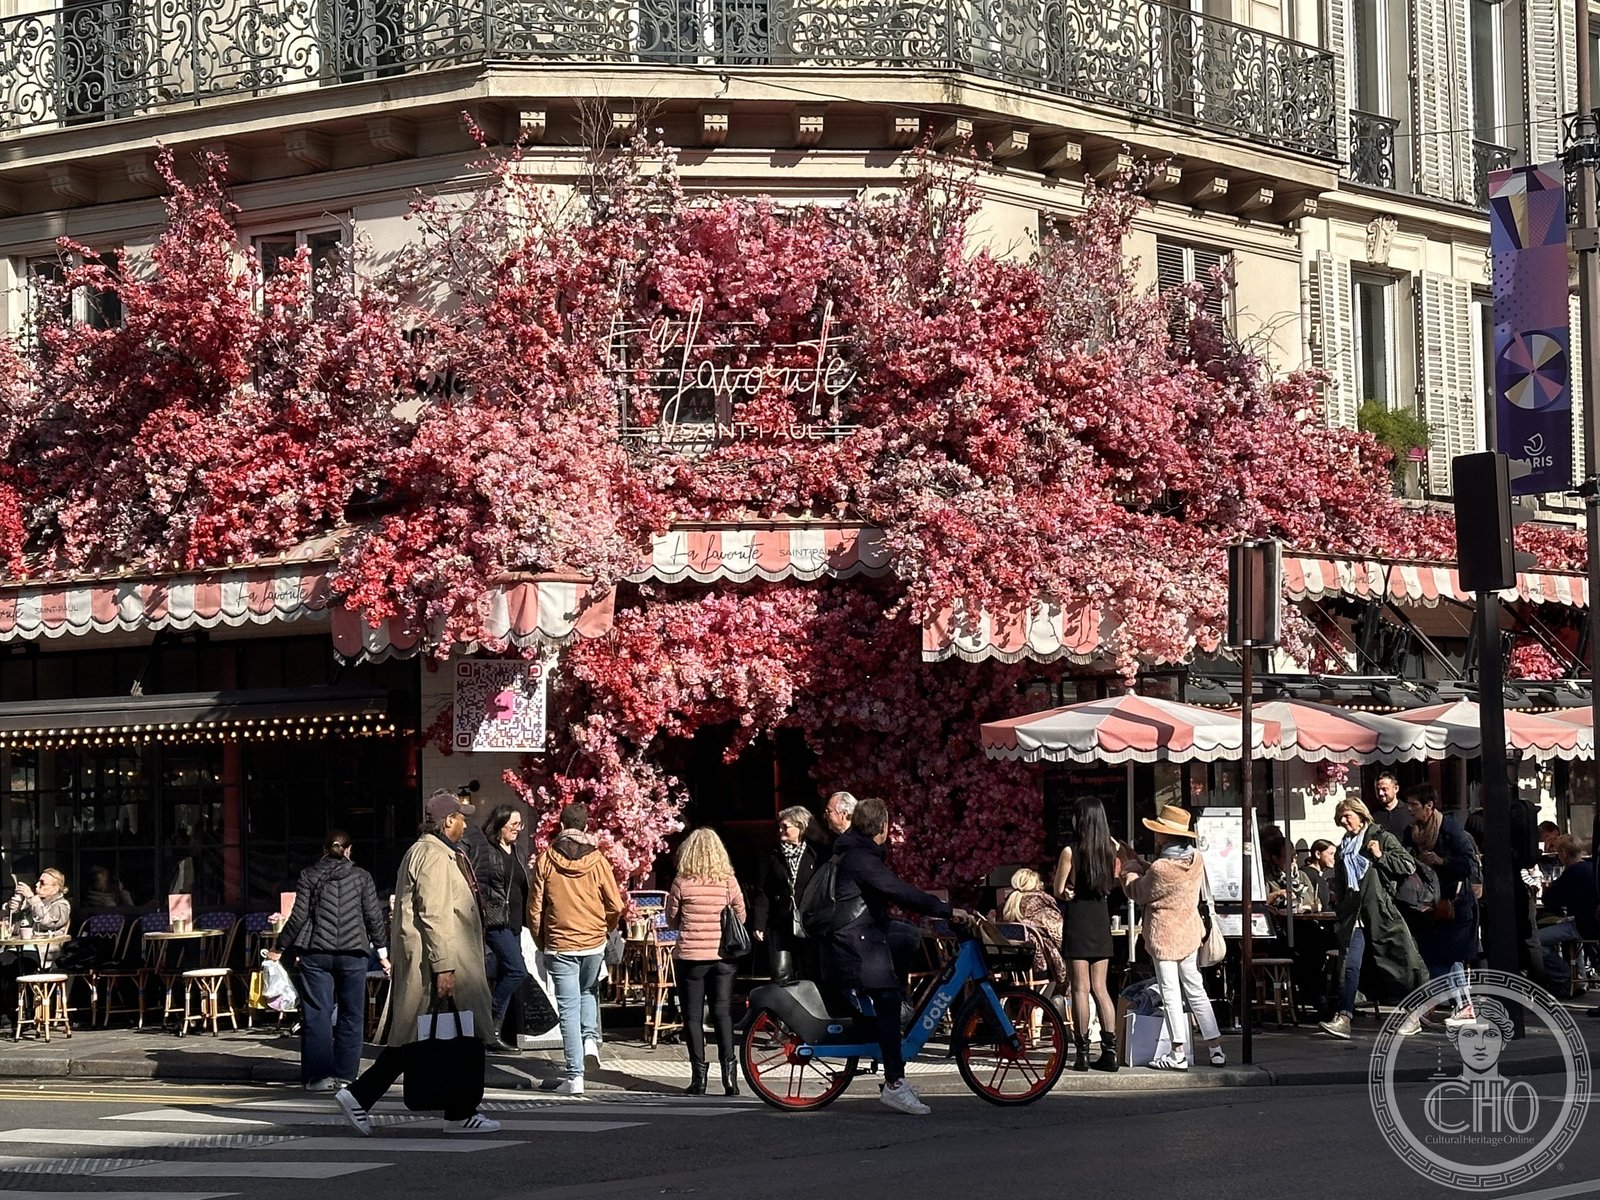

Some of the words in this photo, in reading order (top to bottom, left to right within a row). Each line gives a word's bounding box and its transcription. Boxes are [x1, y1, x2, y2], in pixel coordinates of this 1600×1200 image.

[662, 295, 857, 441] favorite
[680, 422, 823, 440] SAINT-PAUL
[672, 535, 698, 565] La
[702, 534, 764, 570] favorite
[34, 604, 79, 615] SAINT-PAUL
[258, 575, 312, 612] favorite
[922, 992, 953, 1030] dott
